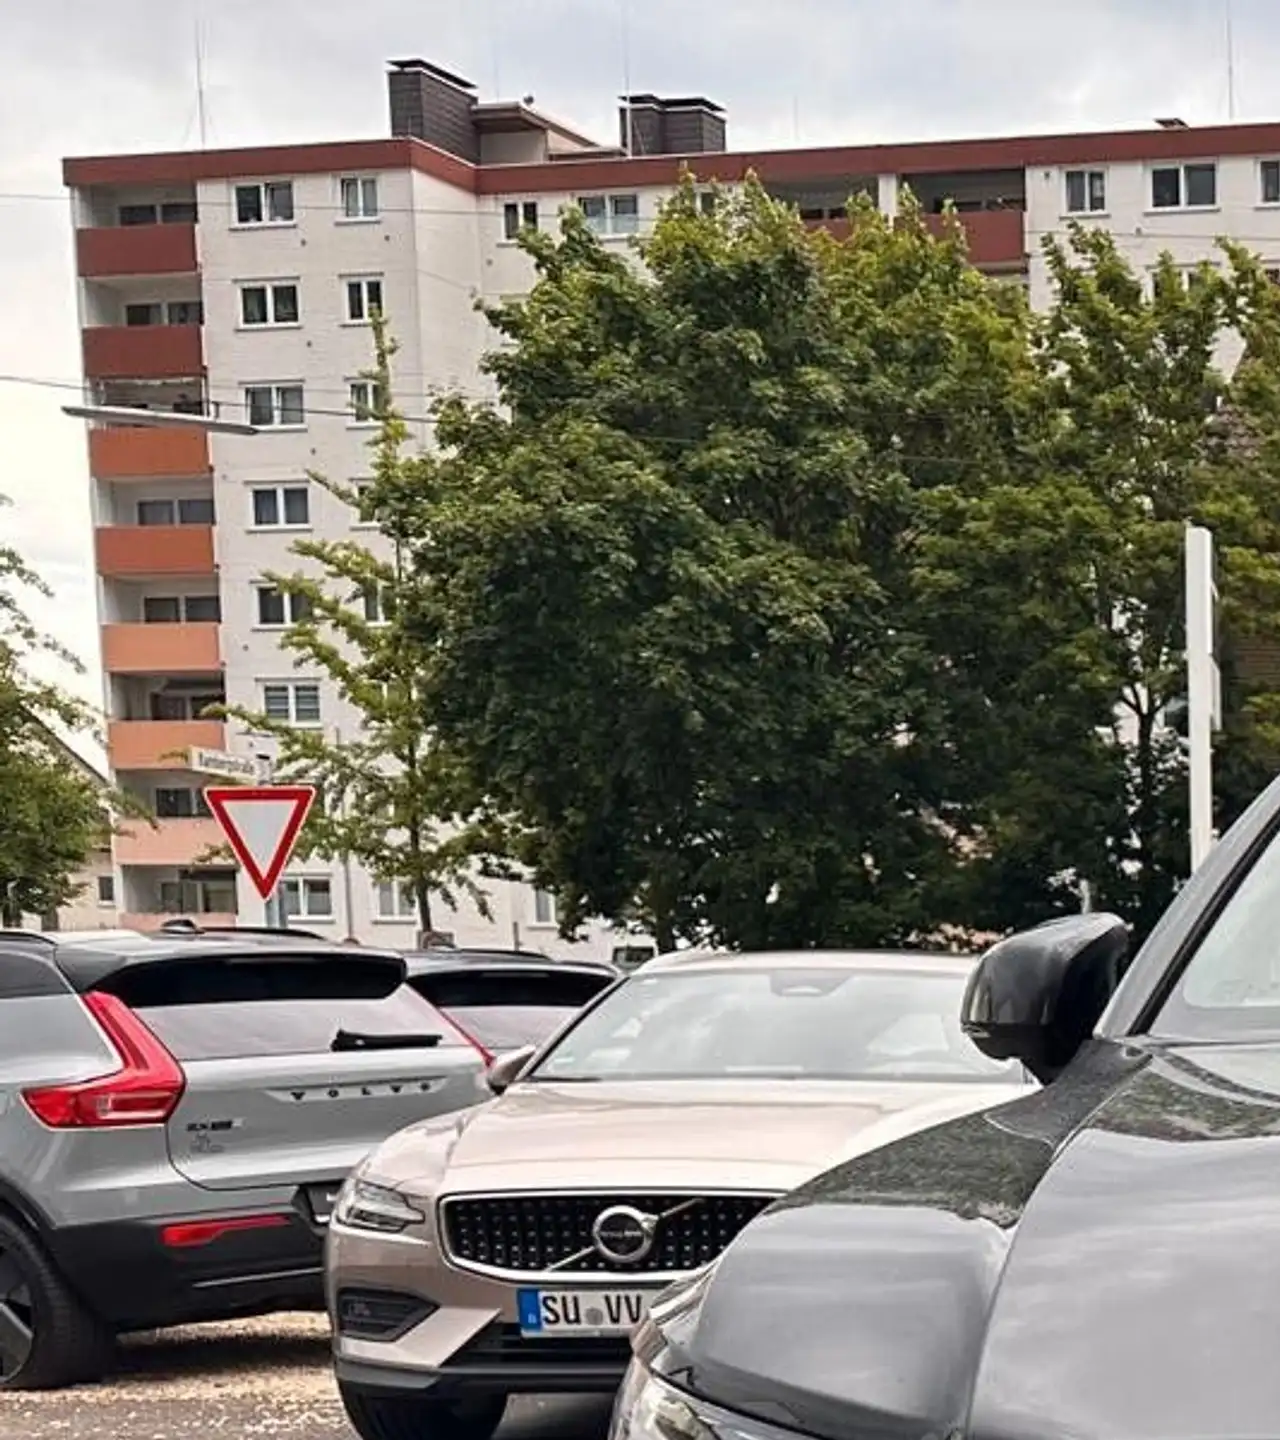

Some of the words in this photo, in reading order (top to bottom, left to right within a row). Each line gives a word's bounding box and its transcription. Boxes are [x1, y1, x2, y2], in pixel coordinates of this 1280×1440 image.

[290, 1080, 432, 1101] VOLVO
[541, 1294, 581, 1325] SU
[604, 1294, 642, 1324] VV
